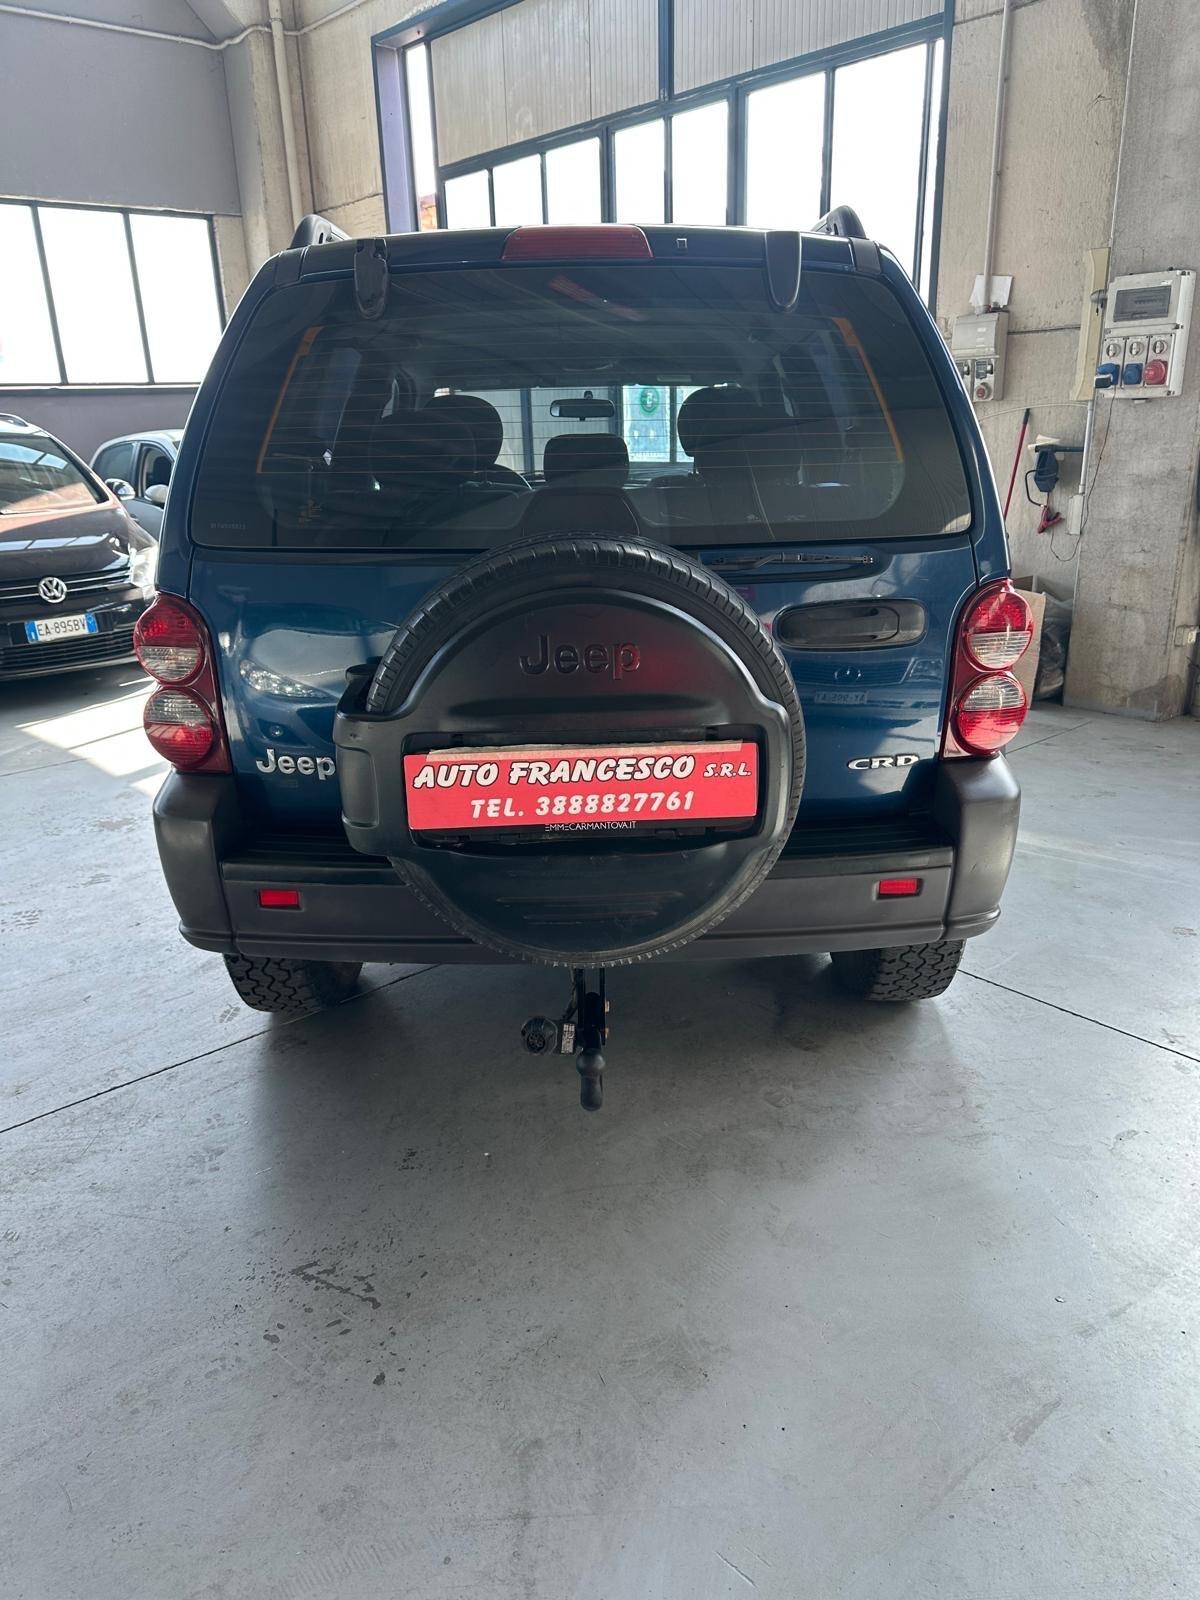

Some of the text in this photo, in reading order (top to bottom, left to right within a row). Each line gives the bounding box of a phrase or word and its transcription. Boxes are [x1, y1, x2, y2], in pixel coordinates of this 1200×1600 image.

[519, 634, 641, 681] Jeep
[255, 748, 336, 780] Jeep
[413, 755, 752, 789] AUTO FRANCESCO S.R.L.
[847, 754, 919, 770] CRD
[470, 790, 695, 820] TEL. 3888827761
